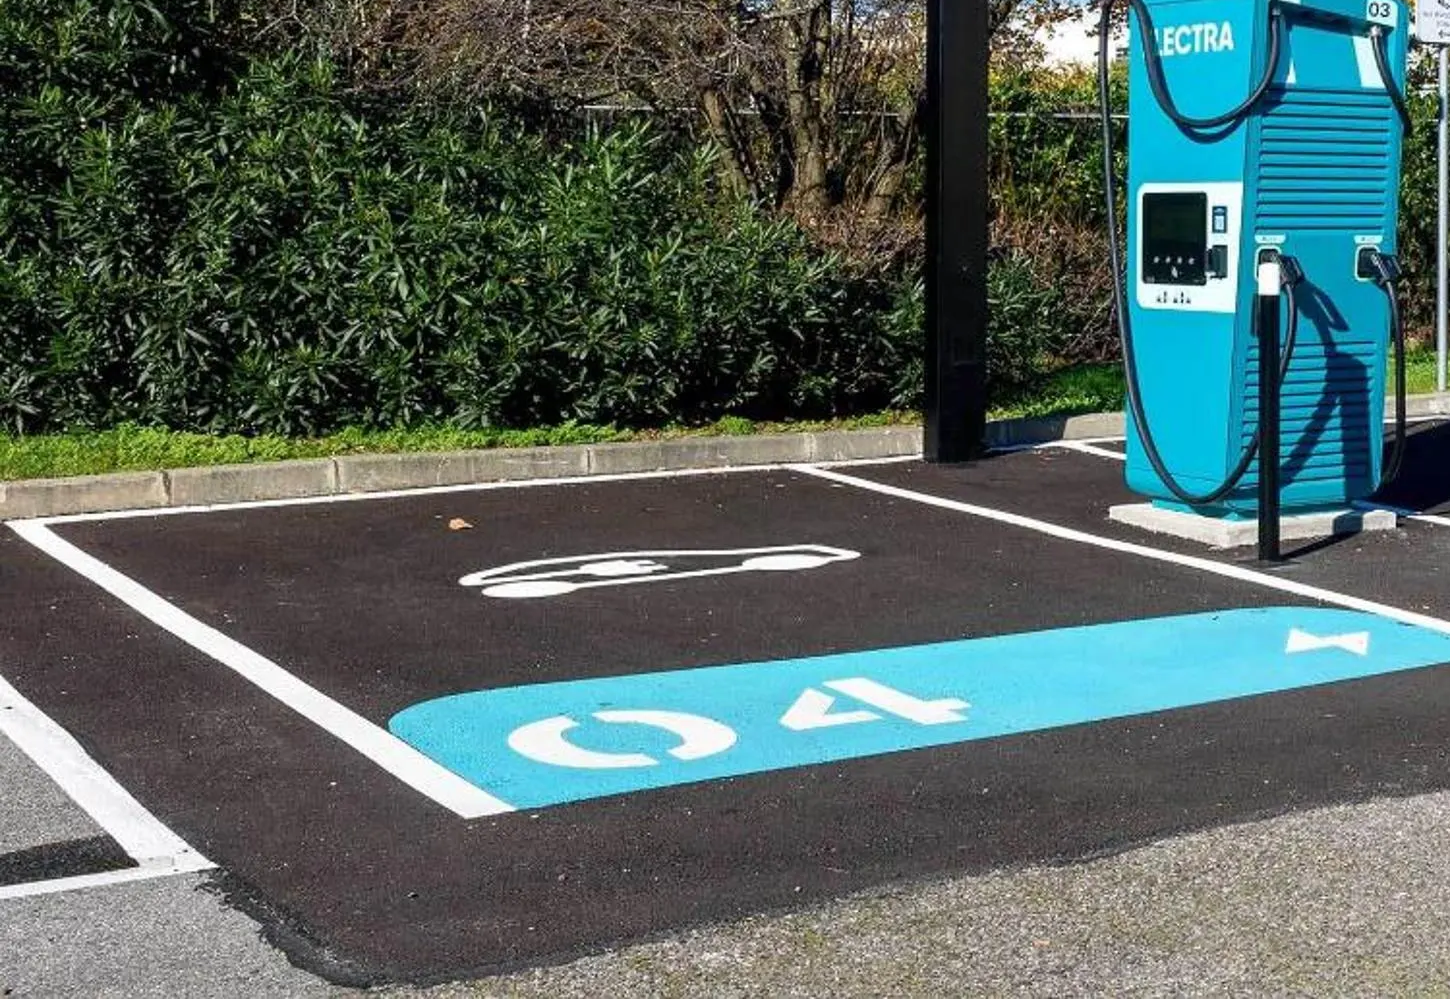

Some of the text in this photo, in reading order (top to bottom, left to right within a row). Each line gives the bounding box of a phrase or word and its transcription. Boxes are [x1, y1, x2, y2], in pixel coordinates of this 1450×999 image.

[1368, 2, 1391, 18] 03
[1153, 21, 1234, 57] ECTRA
[507, 677, 970, 769] 04
